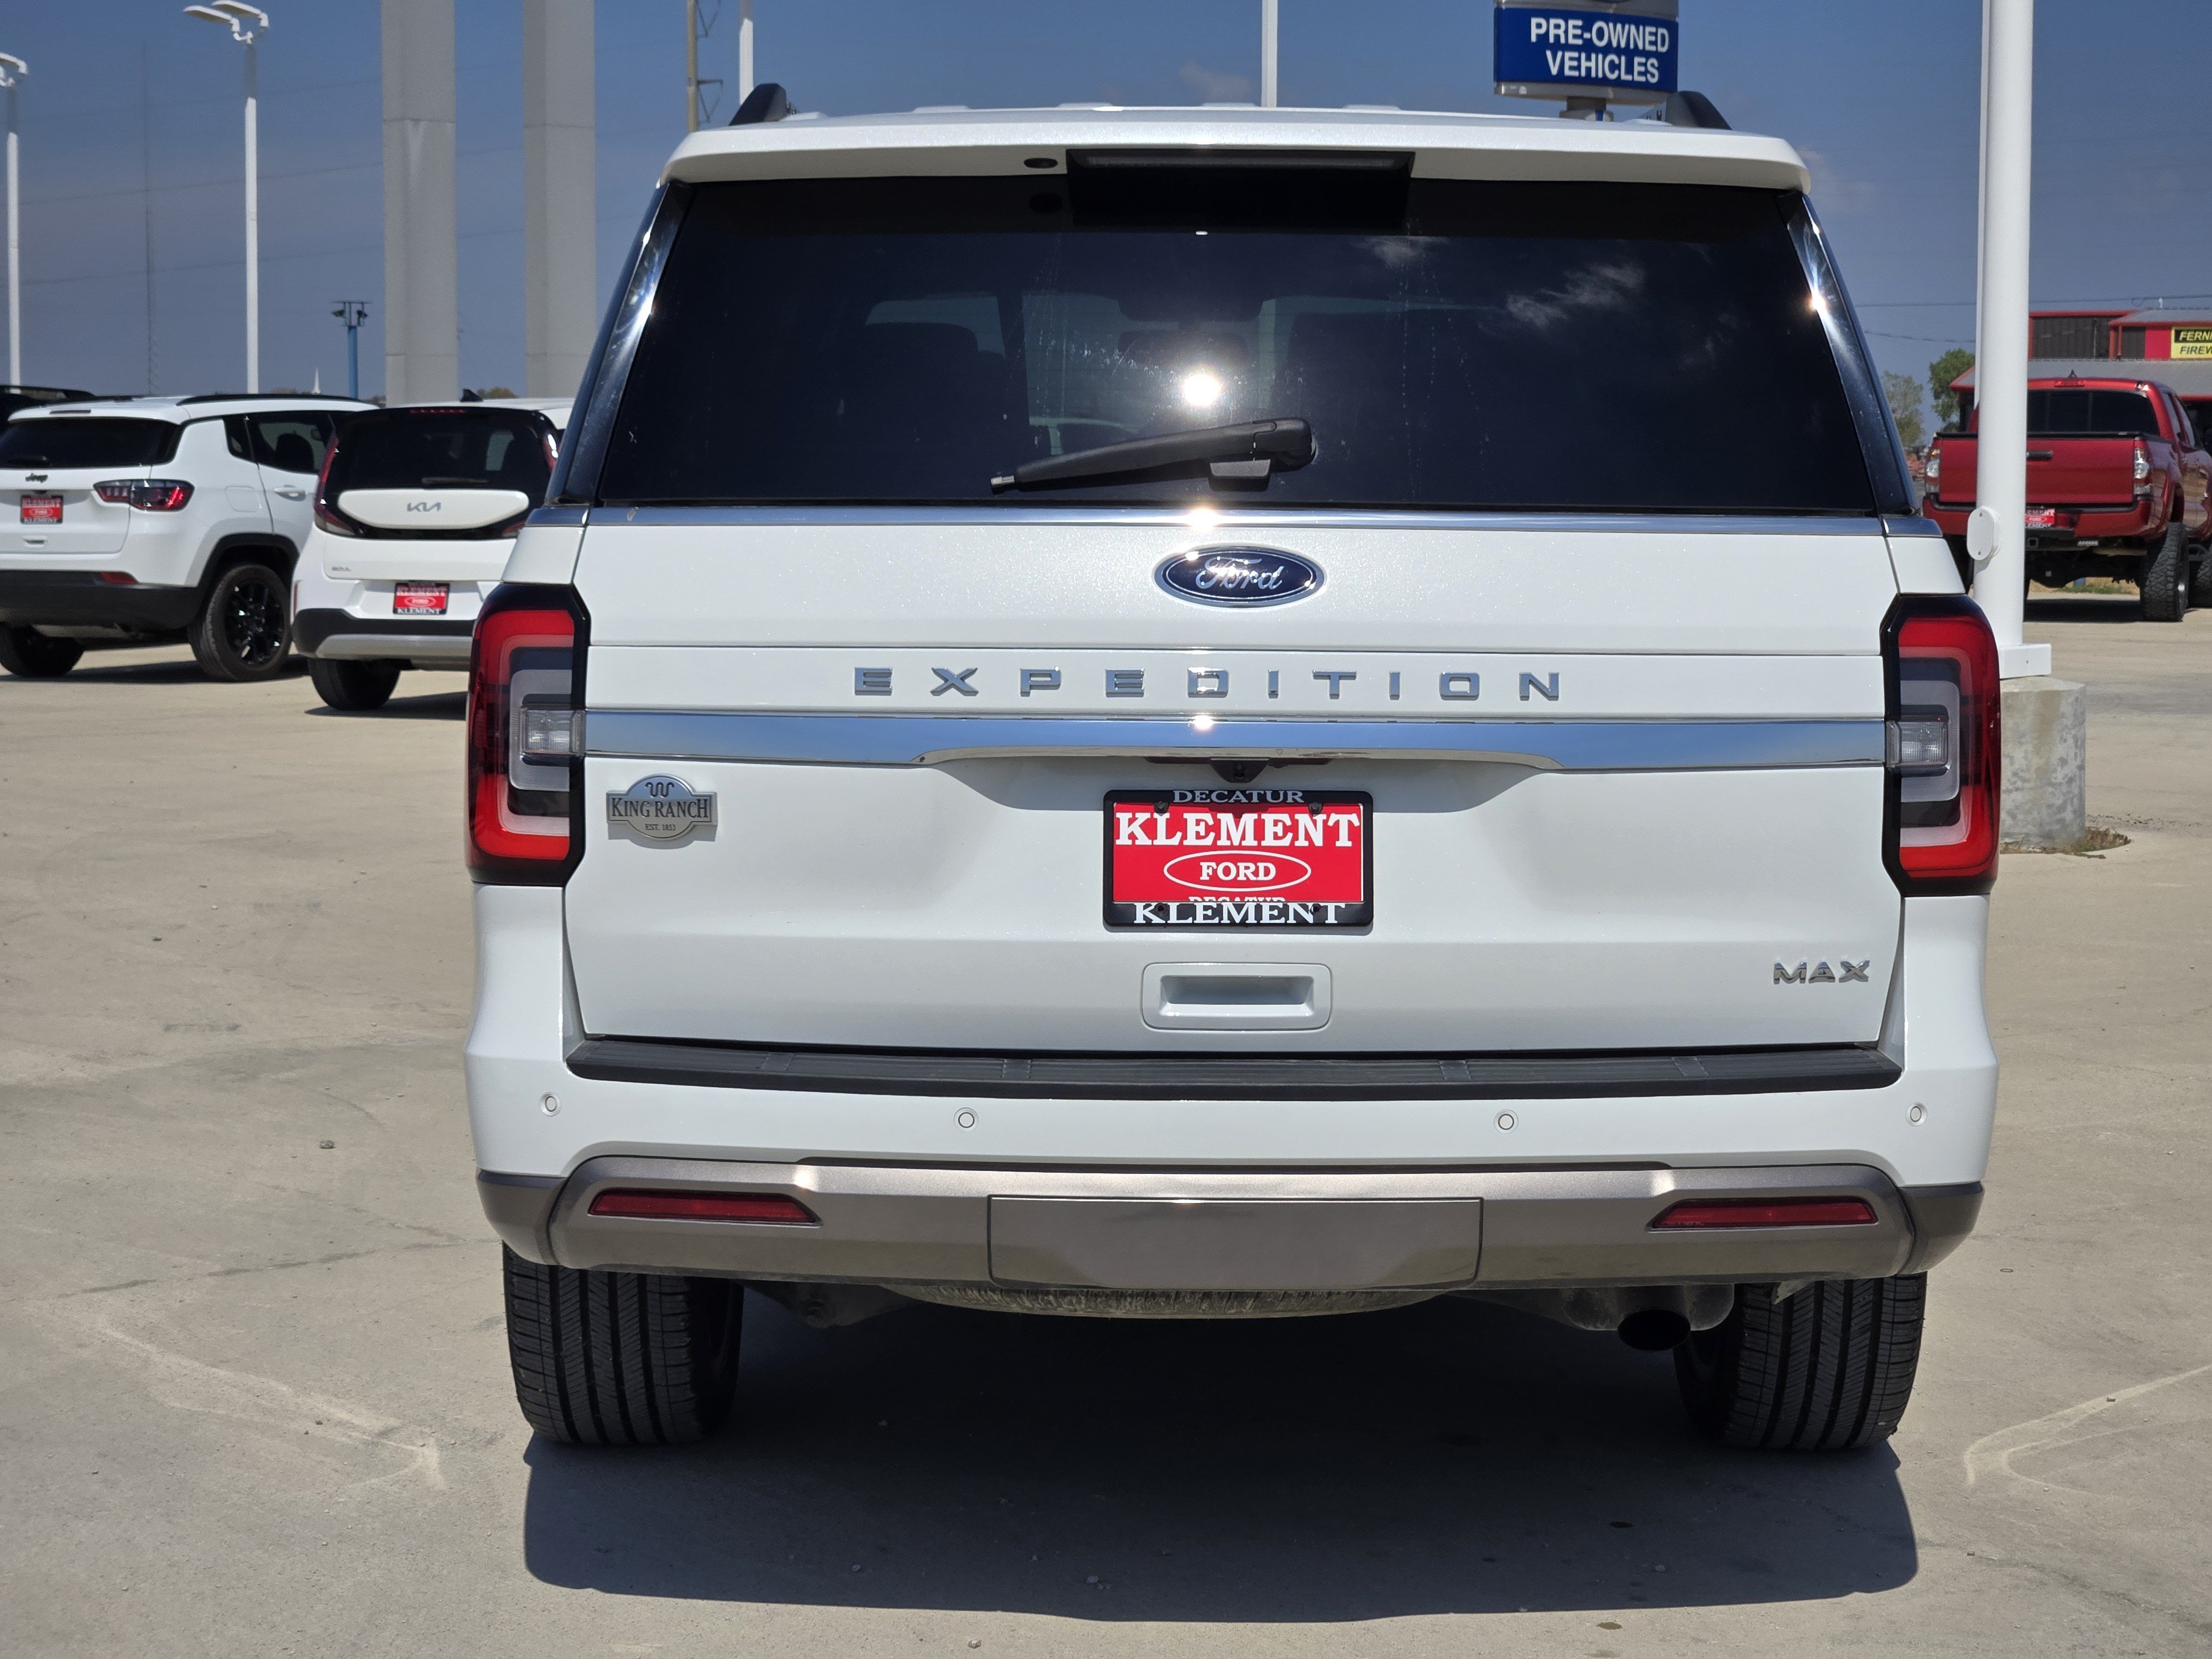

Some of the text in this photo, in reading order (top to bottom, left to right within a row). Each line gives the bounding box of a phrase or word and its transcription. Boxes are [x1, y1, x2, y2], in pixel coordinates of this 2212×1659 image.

[1530, 17, 1669, 53] PRE-OWNED
[1546, 50, 1659, 84] VEHICLES
[2179, 331, 2212, 341] FERN
[1196, 557, 1284, 589] Ford
[854, 667, 1559, 701] EXPEDITION
[612, 798, 708, 818] KING RANCH
[1173, 790, 1305, 803] DECATUR
[1115, 812, 1361, 847] KLEMENT
[1200, 862, 1276, 881] FORD
[1134, 902, 1345, 924] KLEMENT
[1773, 960, 1870, 984] MAX
